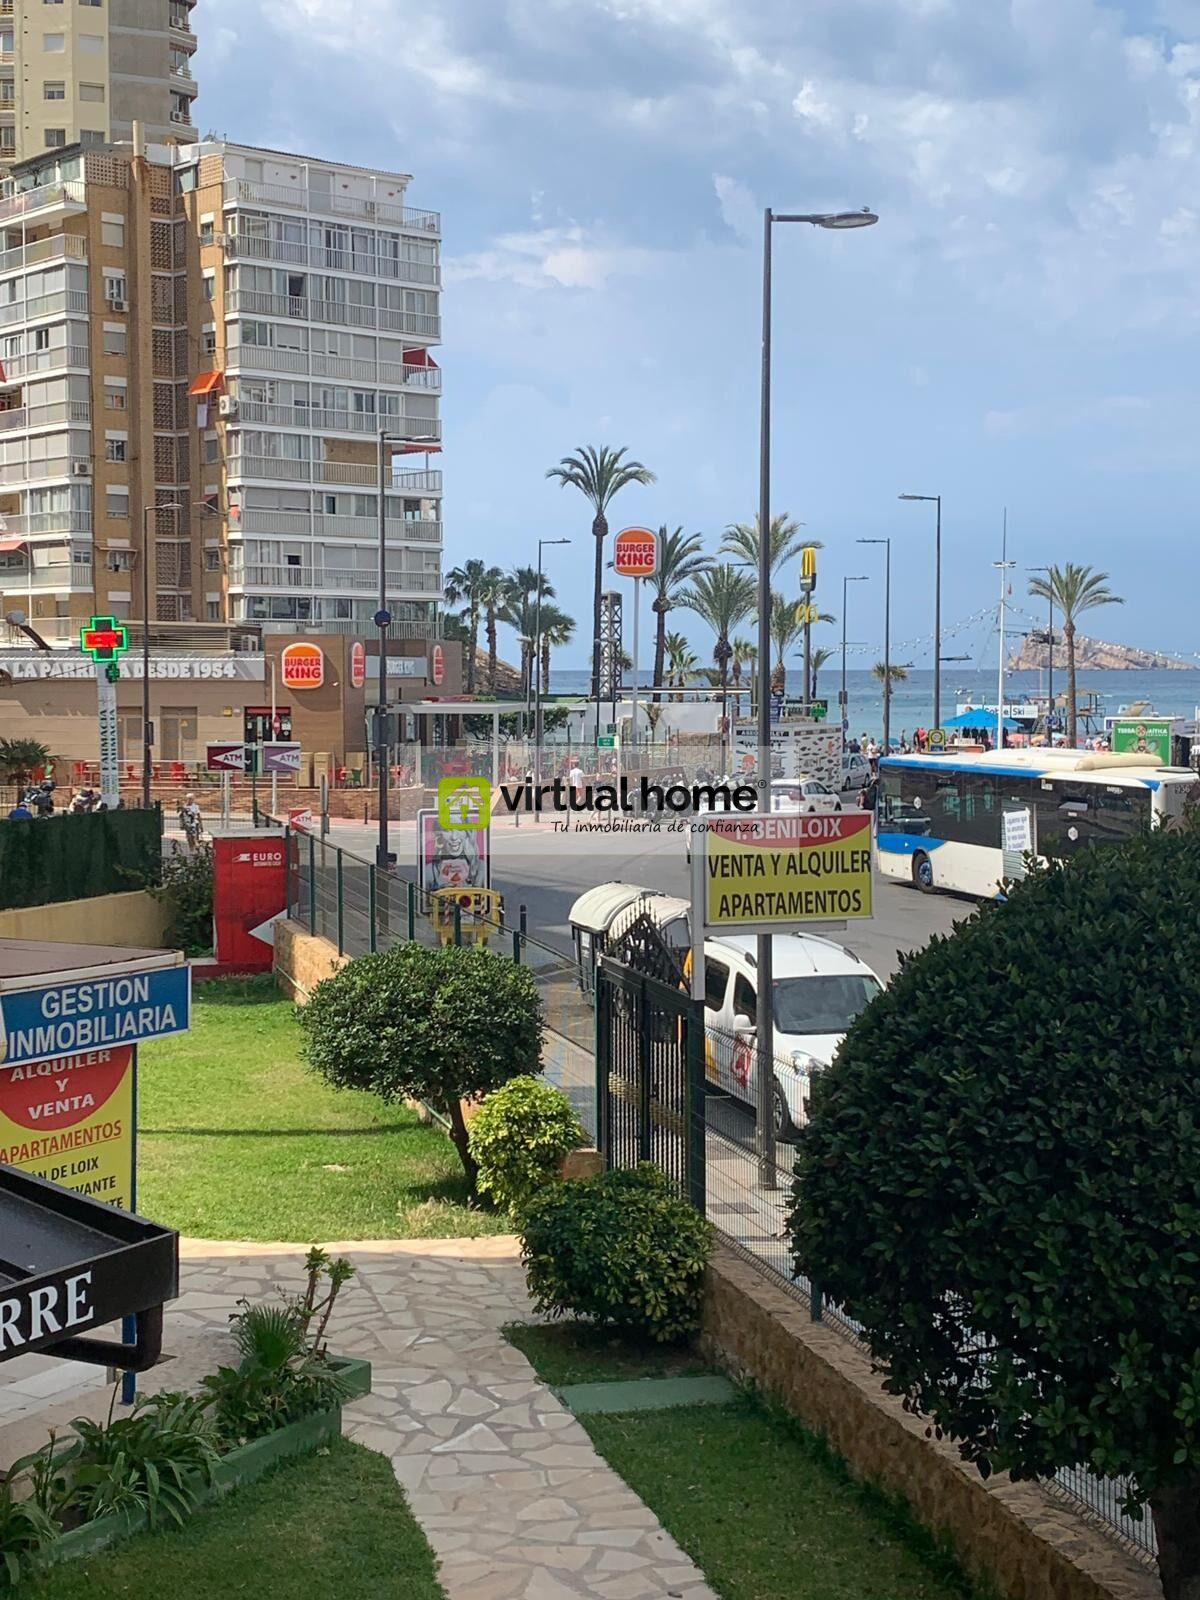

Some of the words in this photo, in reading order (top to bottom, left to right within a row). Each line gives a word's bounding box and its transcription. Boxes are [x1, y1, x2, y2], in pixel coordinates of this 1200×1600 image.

[616, 543, 654, 553] BURGER
[616, 553, 654, 566] KING
[13, 661, 38, 678] LA
[40, 661, 131, 679] PARRIA
[133, 661, 191, 679] DESDE
[192, 661, 236, 679] 1954
[284, 658, 321, 666] BURGER
[284, 667, 321, 679] KING
[1012, 705, 1025, 716] Ski
[100, 709, 109, 771] FARMACIA
[109, 709, 117, 771] FARMACIA
[223, 754, 243, 762] ATM
[280, 754, 300, 762] ATM
[752, 817, 842, 840] BENILOIX
[253, 852, 282, 861] EURO
[708, 853, 766, 879] VENTA
[772, 854, 782, 877] Y
[786, 850, 871, 878] ALQUILER
[718, 889, 862, 917] APARTAMENTOS
[41, 976, 149, 1019] GESTION
[9, 1003, 177, 1059] INMOBILIARIA
[10, 1050, 111, 1082] ALQUILER
[55, 1078, 69, 1092] Y
[28, 1093, 95, 1120] VENTA
[0, 1119, 122, 1164] APARTAMENTOS
[51, 1164, 68, 1181] DE
[71, 1156, 99, 1176] LOIX
